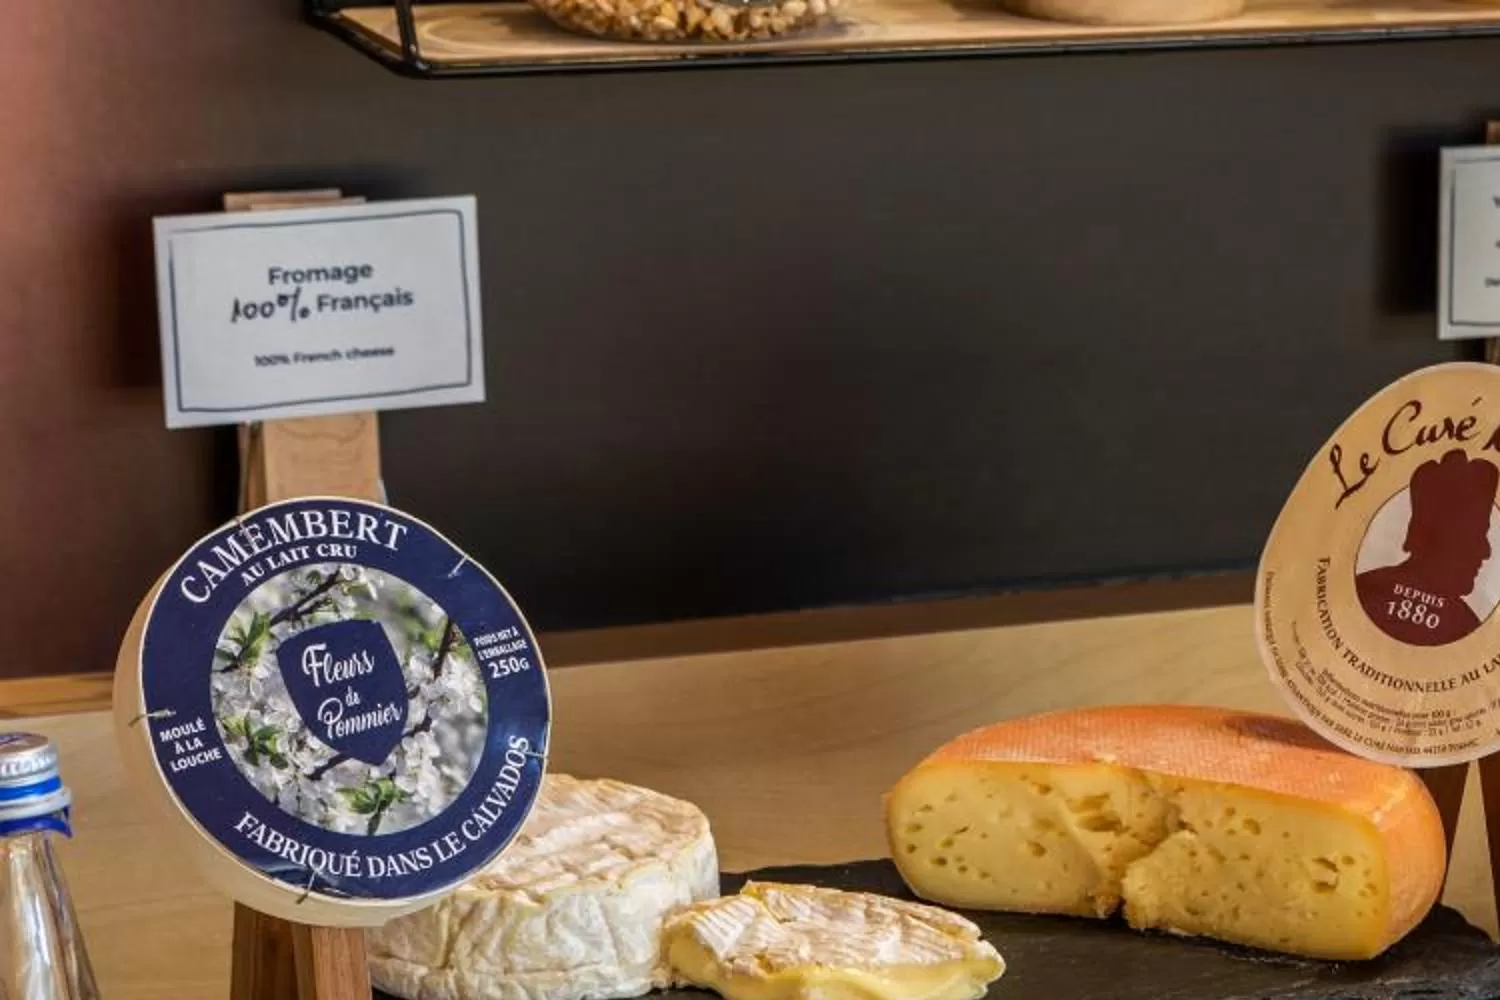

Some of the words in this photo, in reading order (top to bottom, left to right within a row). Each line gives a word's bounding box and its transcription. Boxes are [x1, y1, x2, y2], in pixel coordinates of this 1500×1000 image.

[268, 263, 374, 285] Fromage
[231, 287, 310, 324] 100%
[316, 287, 414, 313] Français
[293, 349, 342, 364] French
[346, 346, 395, 361] cheese
[1329, 443, 1381, 510] Le
[1381, 396, 1483, 456] Curé
[240, 565, 265, 587] AU
[267, 546, 310, 570] LAIT
[317, 543, 358, 559] CRU
[1393, 583, 1447, 609] DEPUIS
[1315, 556, 1344, 650] FABRICATION
[1342, 646, 1457, 694] TRADITIONNELLE
[1460, 669, 1481, 686] AU
[1385, 600, 1441, 630] 1880
[302, 643, 374, 687] Fleurs
[488, 656, 530, 679] 250G
[345, 685, 360, 707] de
[159, 716, 207, 743] MOULÉ
[317, 697, 402, 740] Pommier
[169, 747, 223, 772] LOUCHE
[174, 741, 186, 755] À
[186, 737, 203, 751] LA
[233, 811, 362, 878] FABRIQUÉ
[368, 847, 433, 879] DANS
[435, 831, 467, 864] LE
[461, 735, 529, 842] CALVADOS
